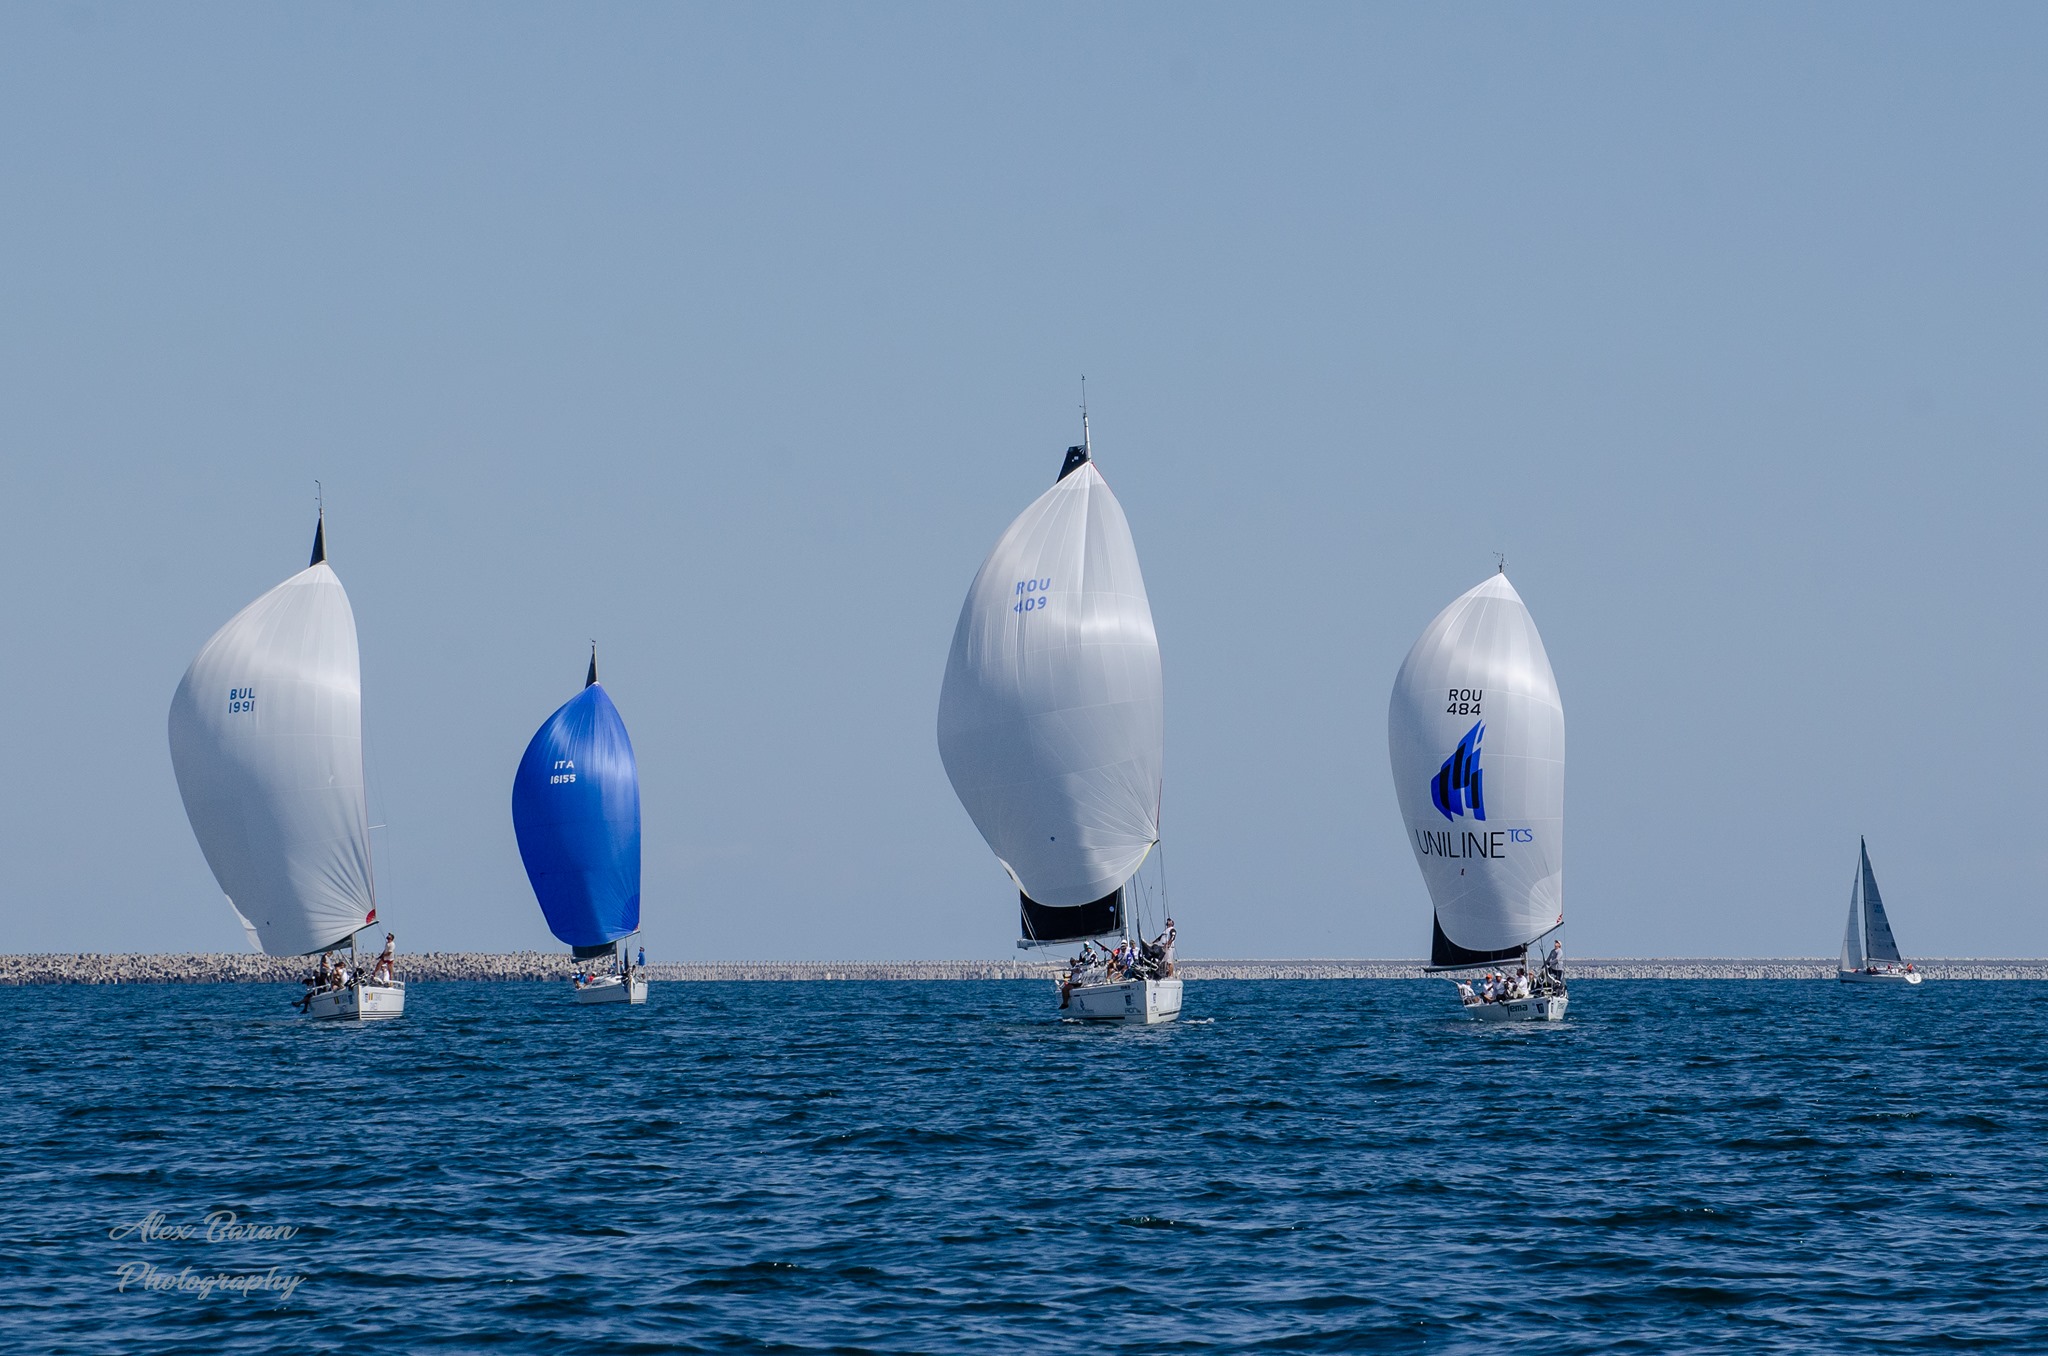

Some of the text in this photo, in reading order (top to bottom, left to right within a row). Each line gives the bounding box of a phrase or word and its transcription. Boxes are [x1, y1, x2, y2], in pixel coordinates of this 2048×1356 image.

[1016, 578, 1051, 595] ROU
[1013, 596, 1047, 613] 409
[229, 687, 256, 700] BUL
[1448, 689, 1482, 702] ROU
[228, 700, 255, 713] 1991
[1446, 703, 1481, 716] 484
[554, 760, 575, 770] ITA
[550, 774, 577, 785] 16155
[1415, 828, 1533, 859] UNILINE TCS
